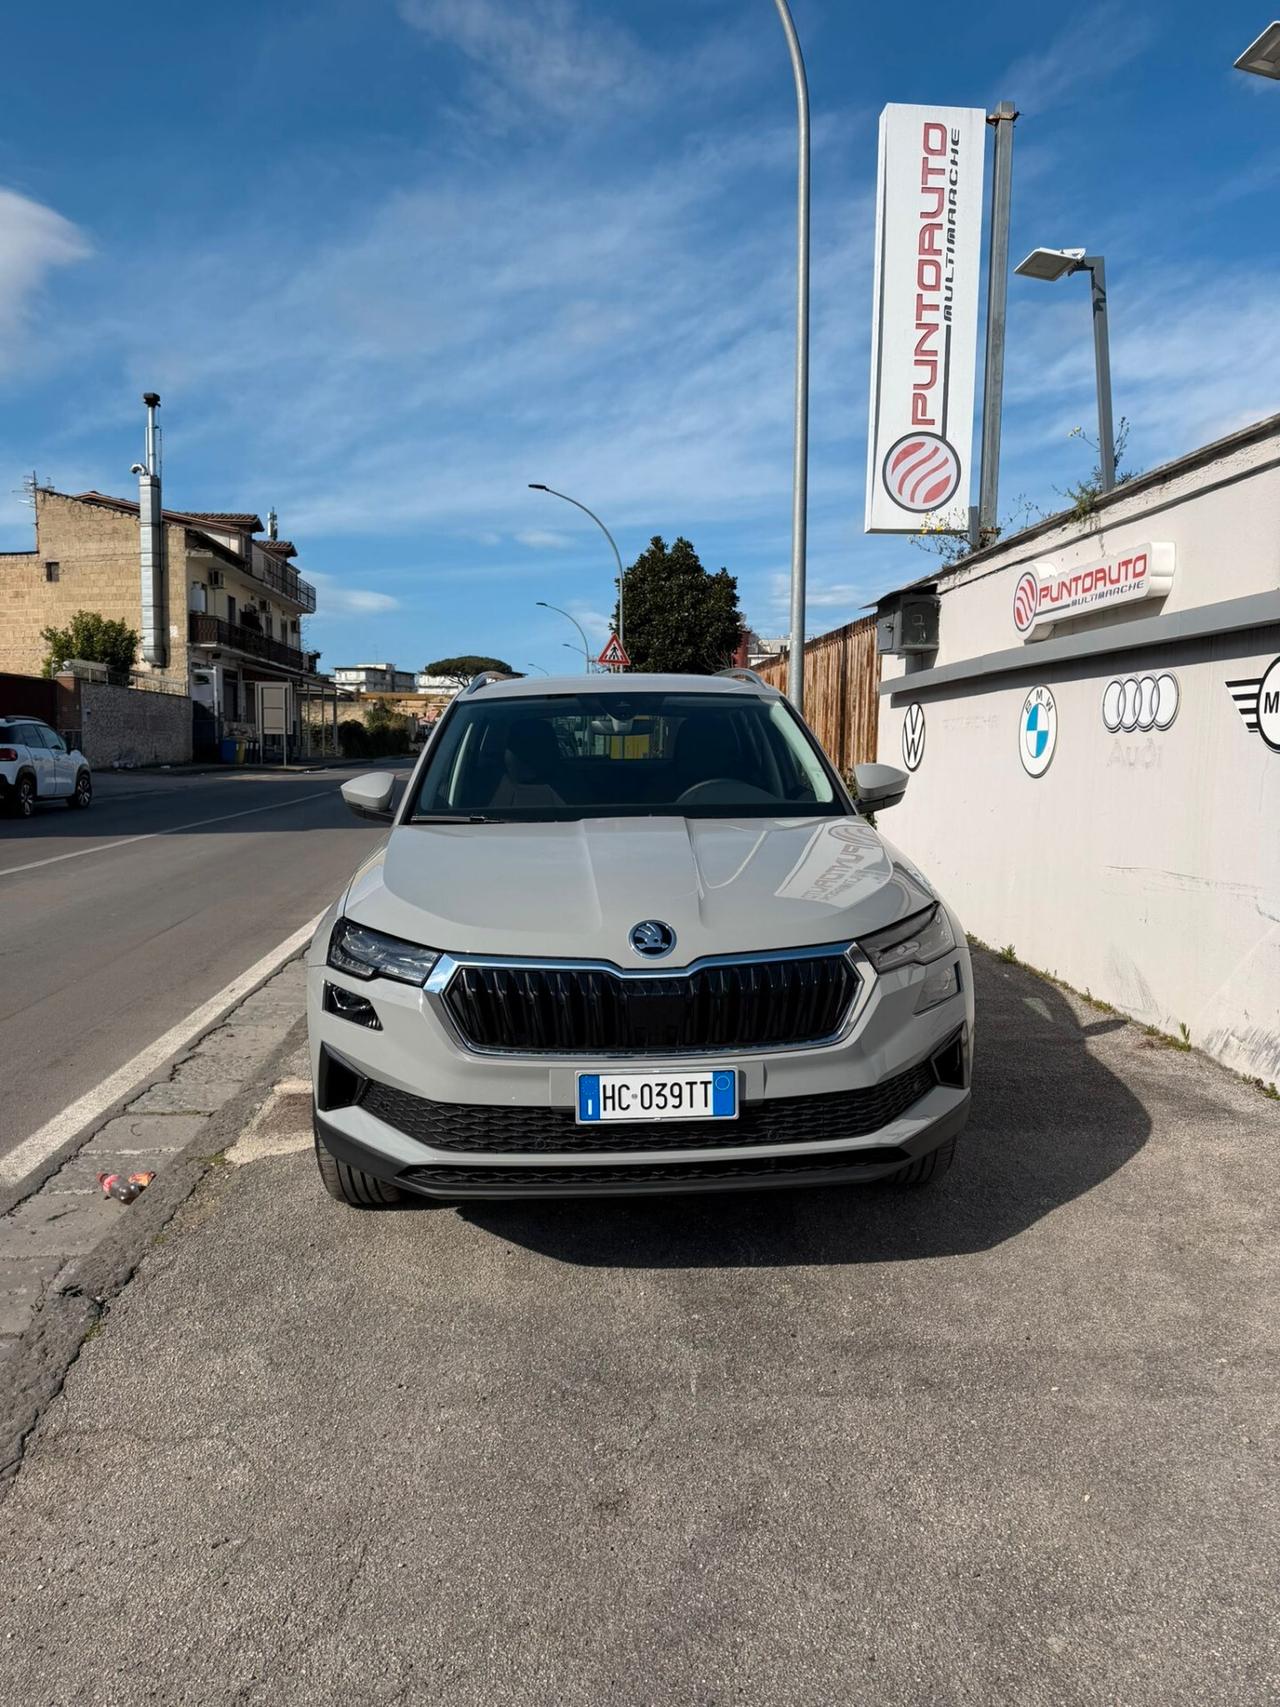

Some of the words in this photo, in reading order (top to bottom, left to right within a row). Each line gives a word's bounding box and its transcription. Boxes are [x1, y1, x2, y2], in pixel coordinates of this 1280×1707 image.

[911, 122, 948, 426] PUNTOAUTO
[943, 128, 961, 322] MULTIMARCHE
[1038, 553, 1148, 606] PUNTOAUTO
